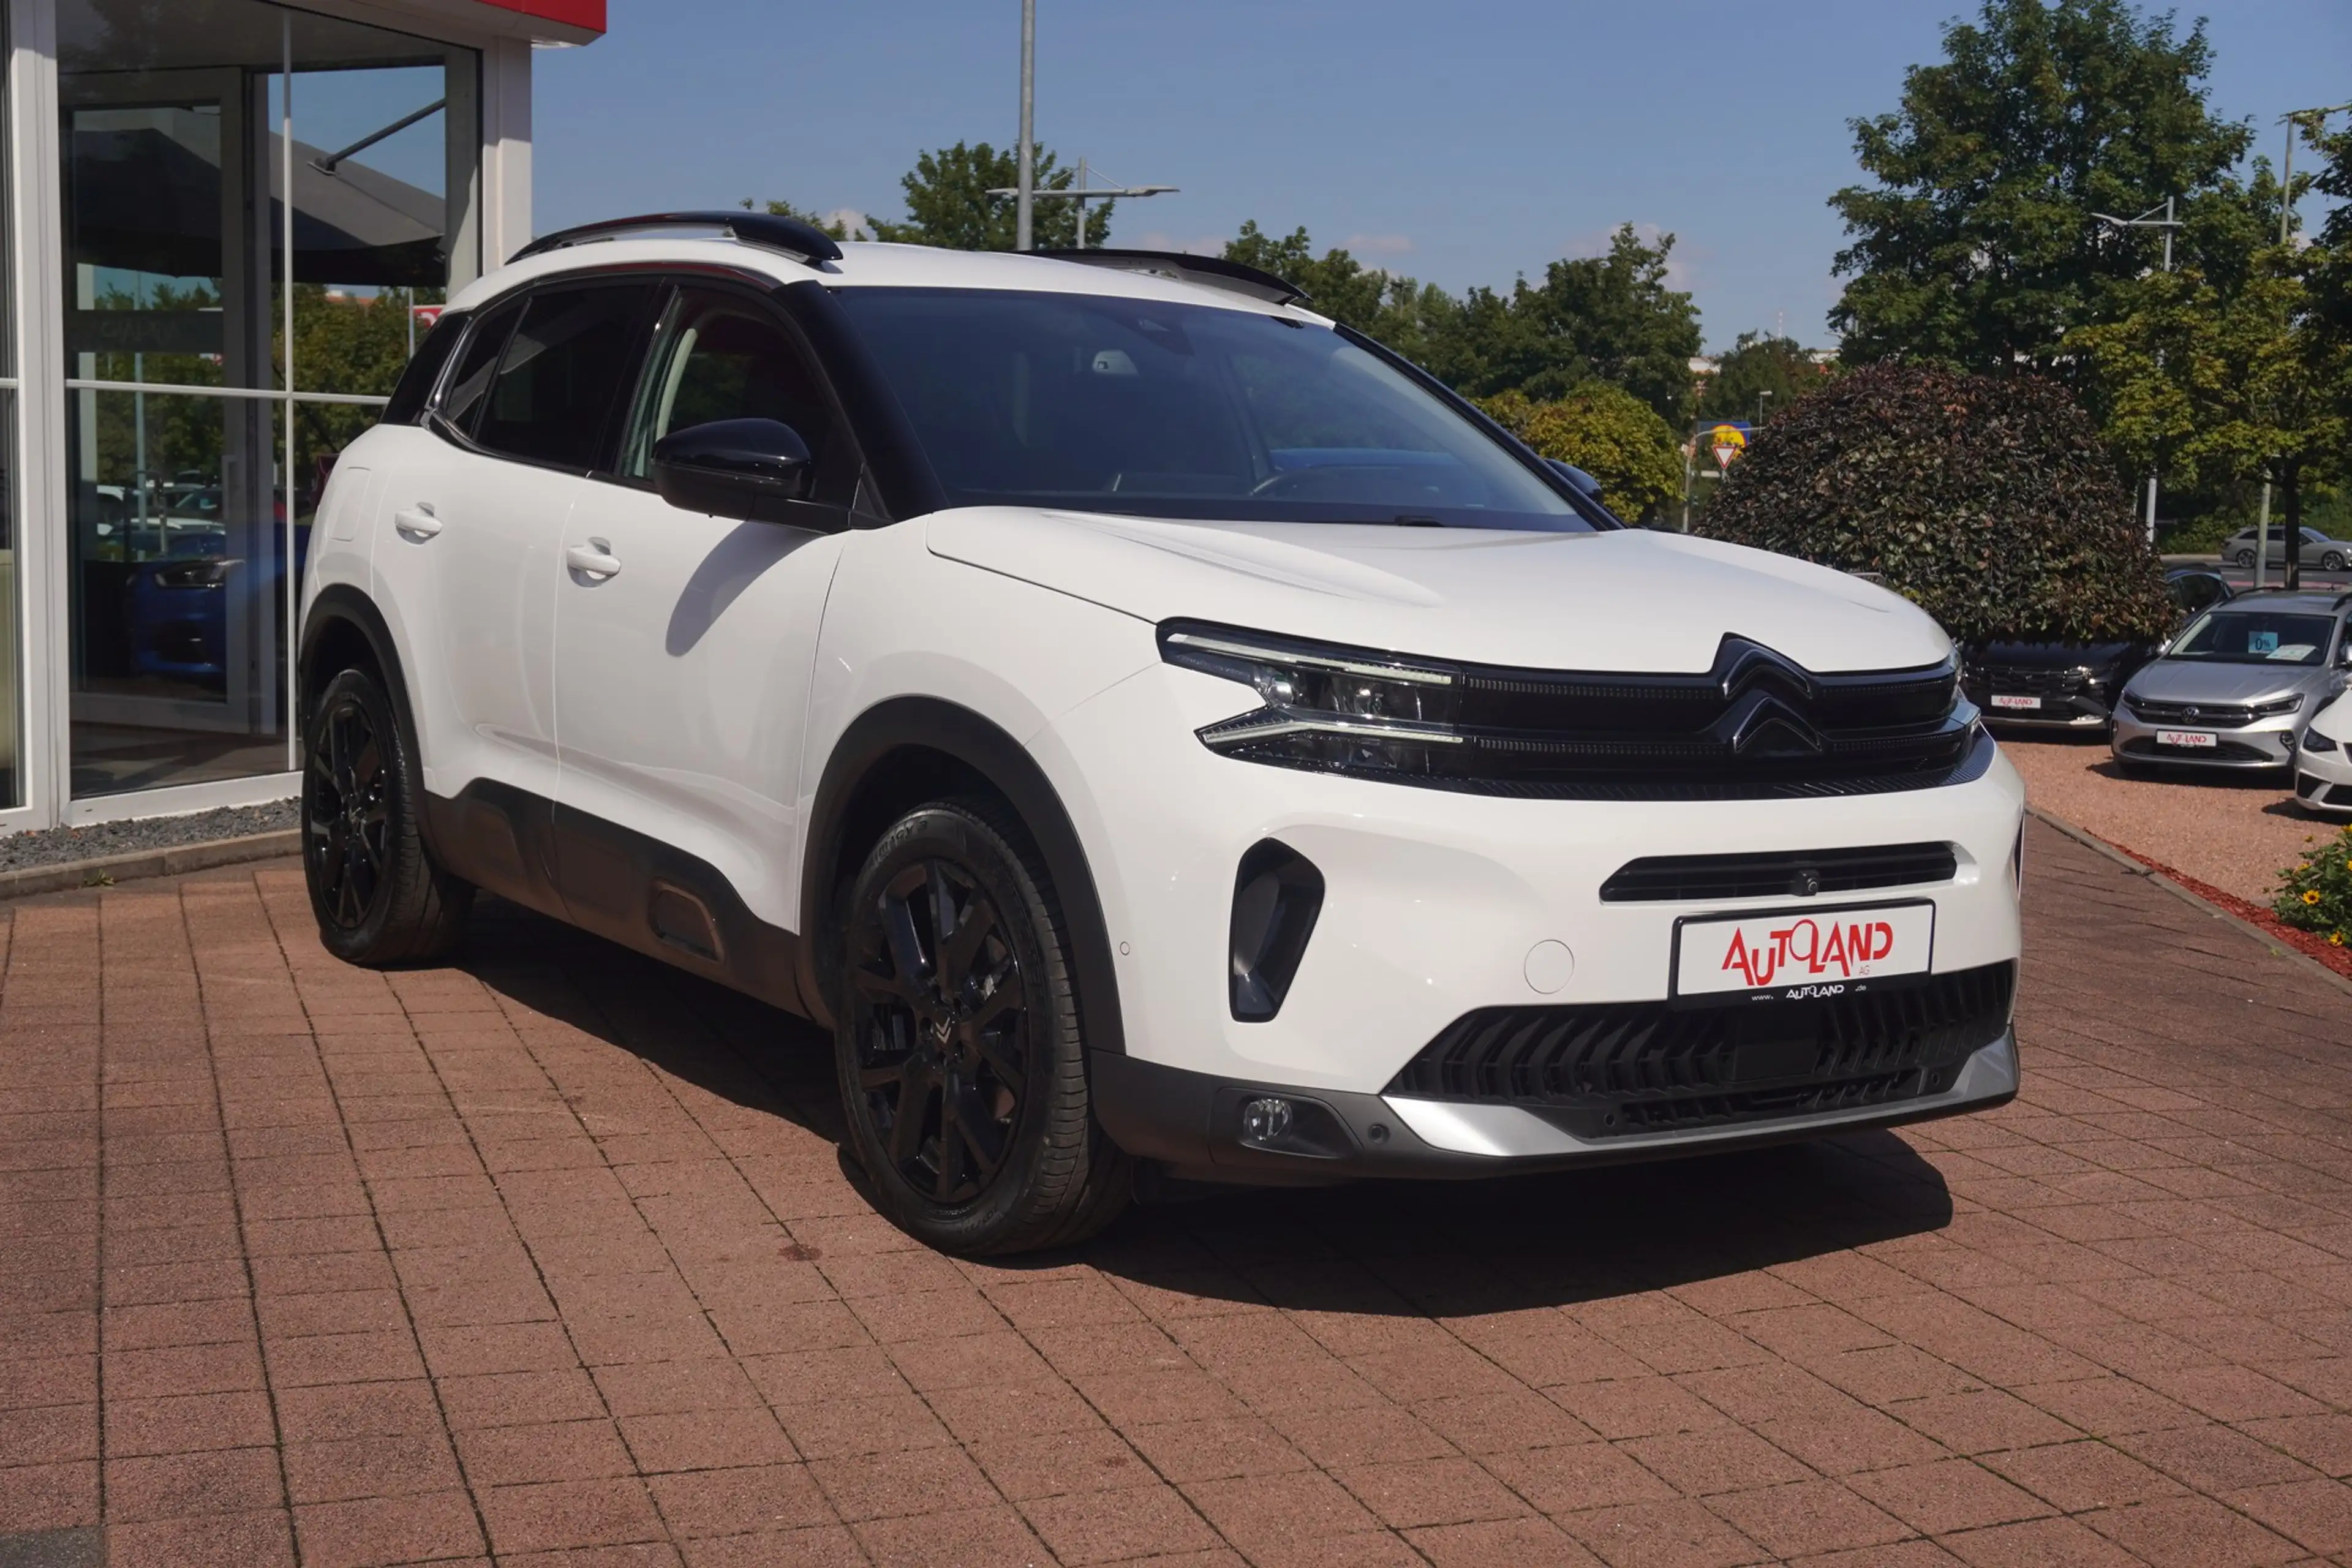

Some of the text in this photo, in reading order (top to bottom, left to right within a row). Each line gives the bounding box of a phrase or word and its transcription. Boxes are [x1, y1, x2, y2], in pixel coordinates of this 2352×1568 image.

[2255, 638, 2271, 650] 0%
[1999, 697, 2033, 706] AUTLAND
[1722, 919, 1893, 986] AUTOLAND
[1858, 965, 1870, 976] AG
[1786, 985, 1844, 1000] AUTOLAND
